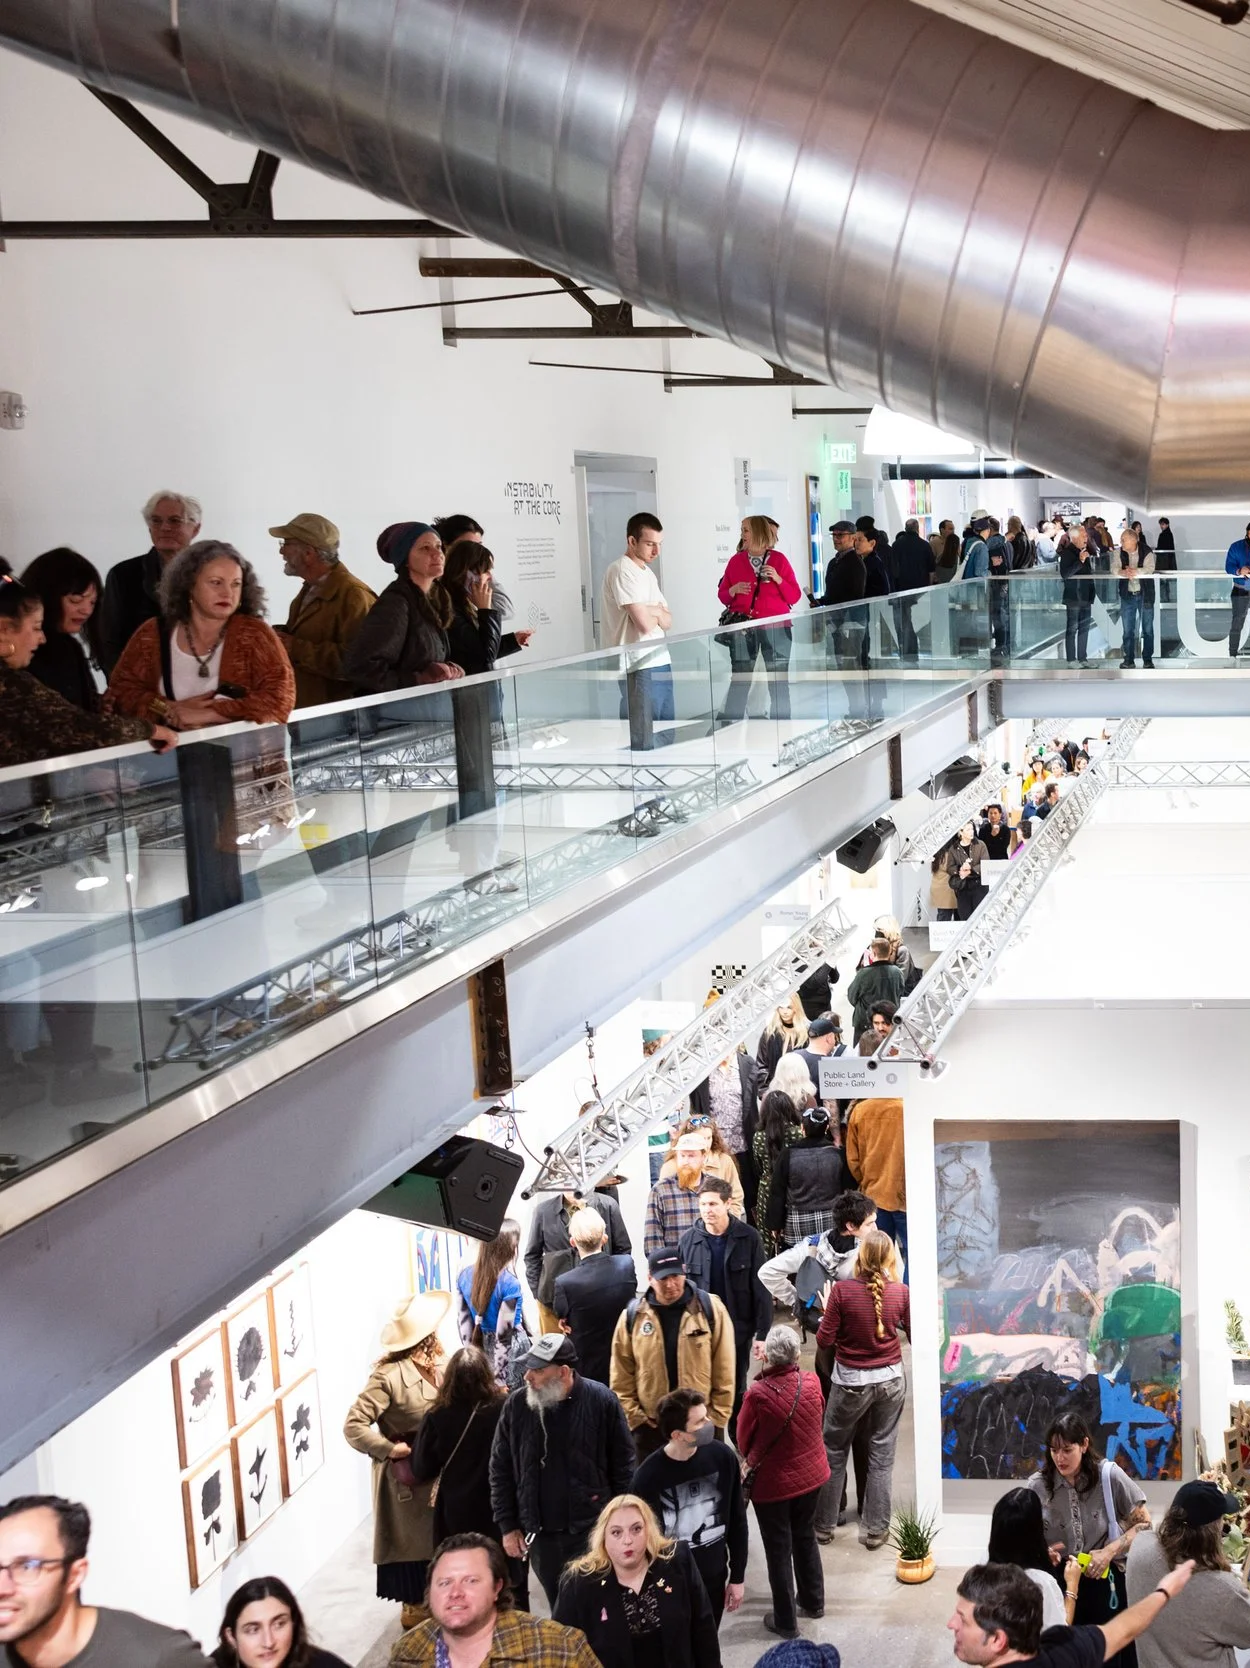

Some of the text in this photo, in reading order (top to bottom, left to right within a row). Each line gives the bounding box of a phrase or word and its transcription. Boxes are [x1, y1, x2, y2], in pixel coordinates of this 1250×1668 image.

[504, 482, 553, 498] INSTABILITY
[514, 500, 560, 525] AT THE CORE
[851, 1080, 876, 1088] Gallery
